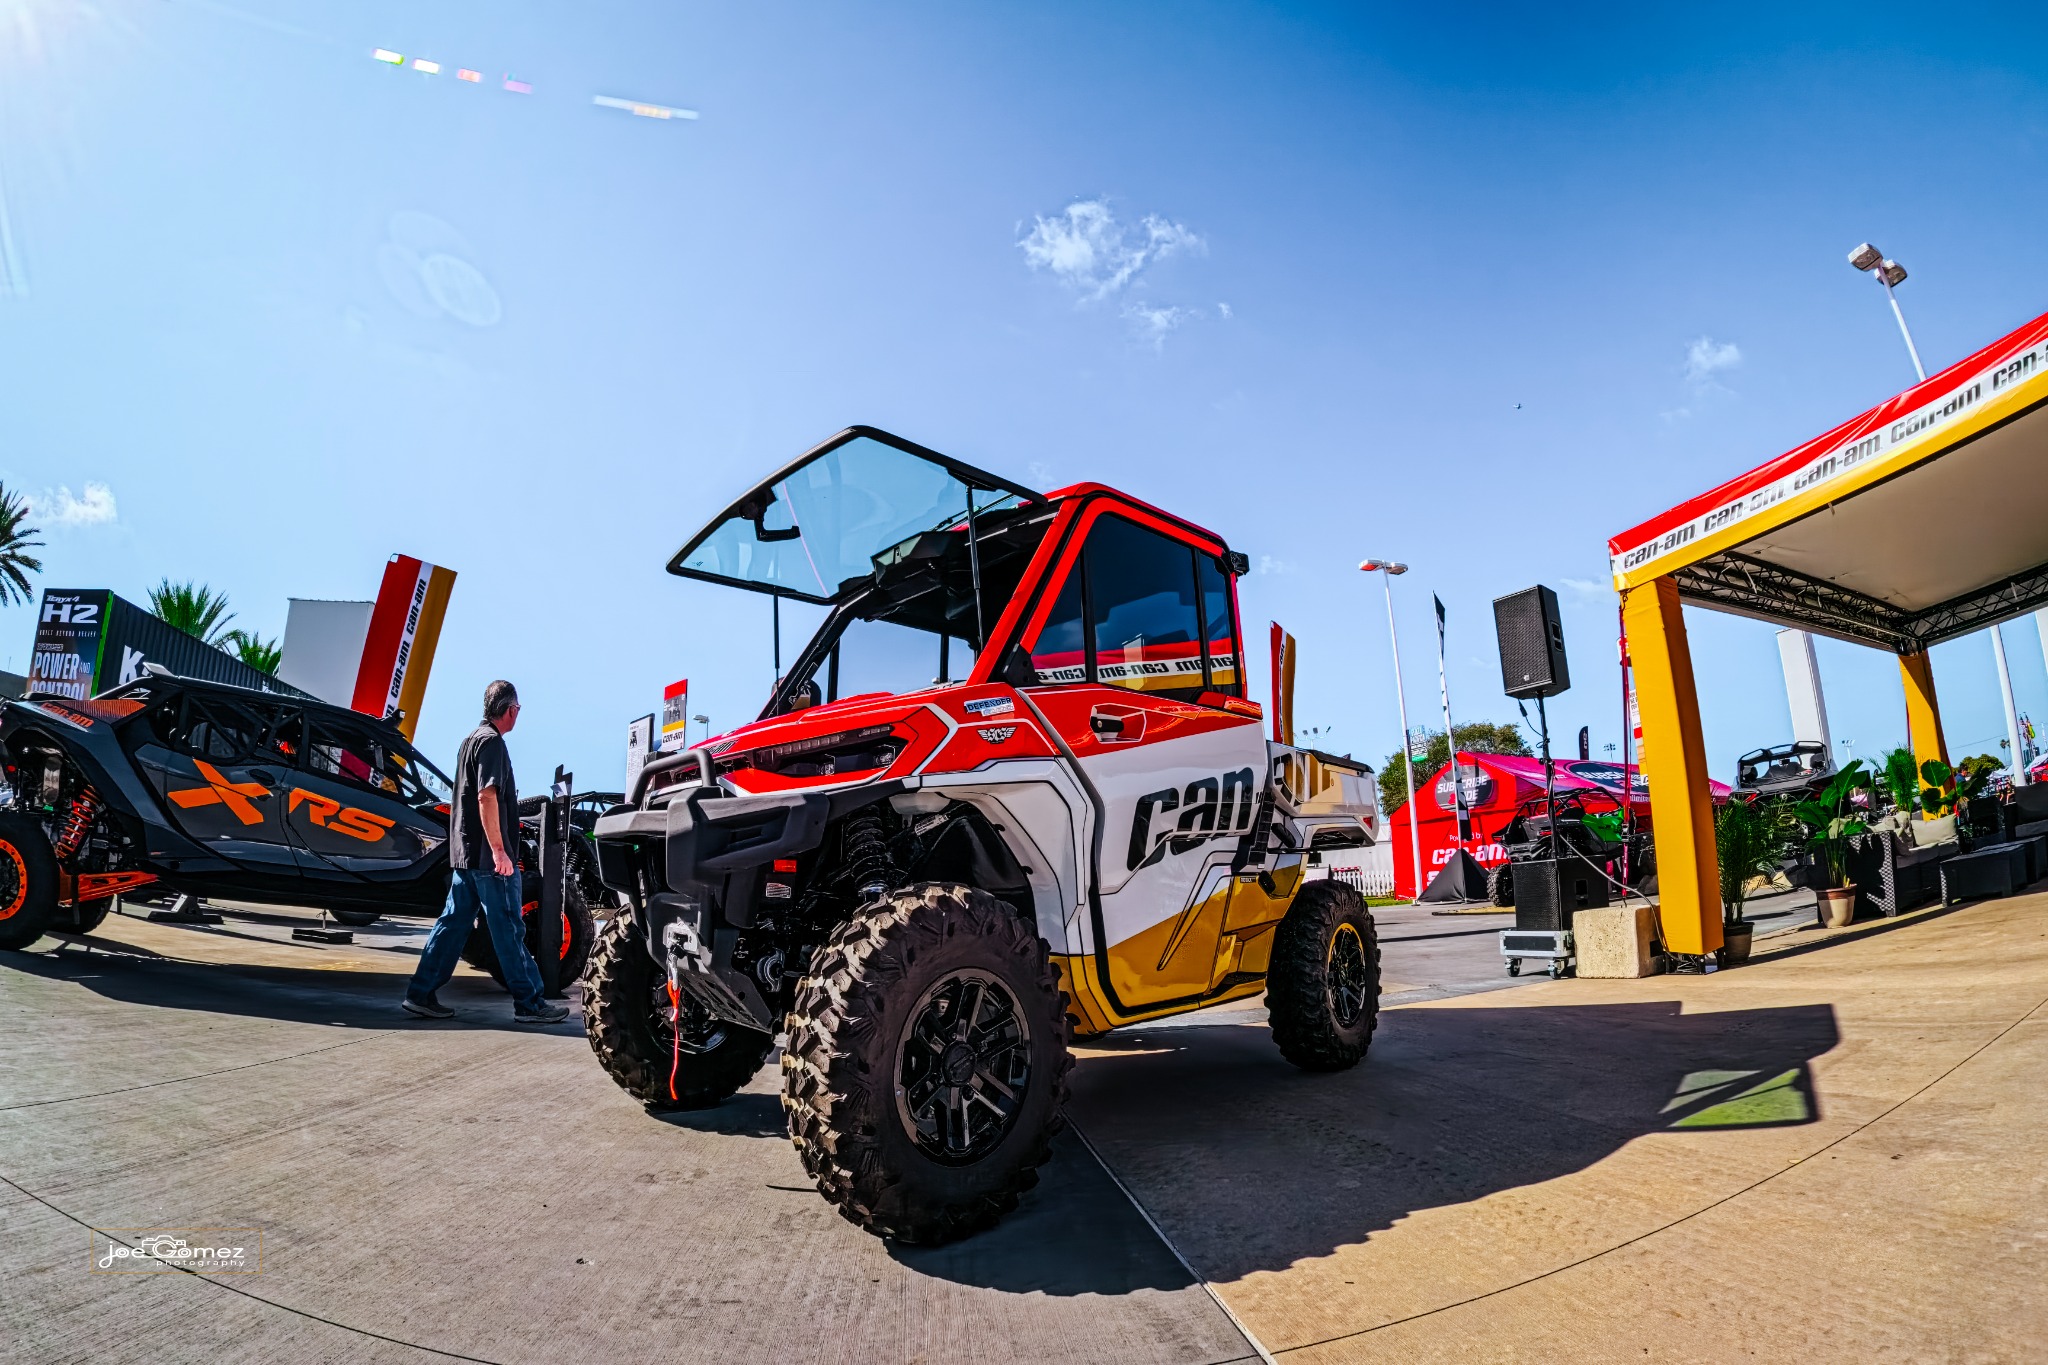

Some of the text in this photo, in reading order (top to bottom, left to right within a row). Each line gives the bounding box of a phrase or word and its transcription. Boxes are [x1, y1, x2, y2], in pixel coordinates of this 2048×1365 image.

[1624, 523, 1696, 569] can-am
[1704, 482, 1785, 533] can-am
[1794, 433, 1882, 490] can-am
[1891, 382, 1982, 444] can-am
[41, 603, 98, 623] H2
[406, 578, 427, 635] can-am
[32, 651, 80, 680] POWER
[390, 640, 411, 698] can-am
[41, 702, 94, 727] can-am
[966, 697, 1012, 711] DEFENDER
[1437, 775, 1488, 793] SUBCRIBE
[289, 788, 396, 842] RS
[1432, 844, 1508, 865] ca-am
